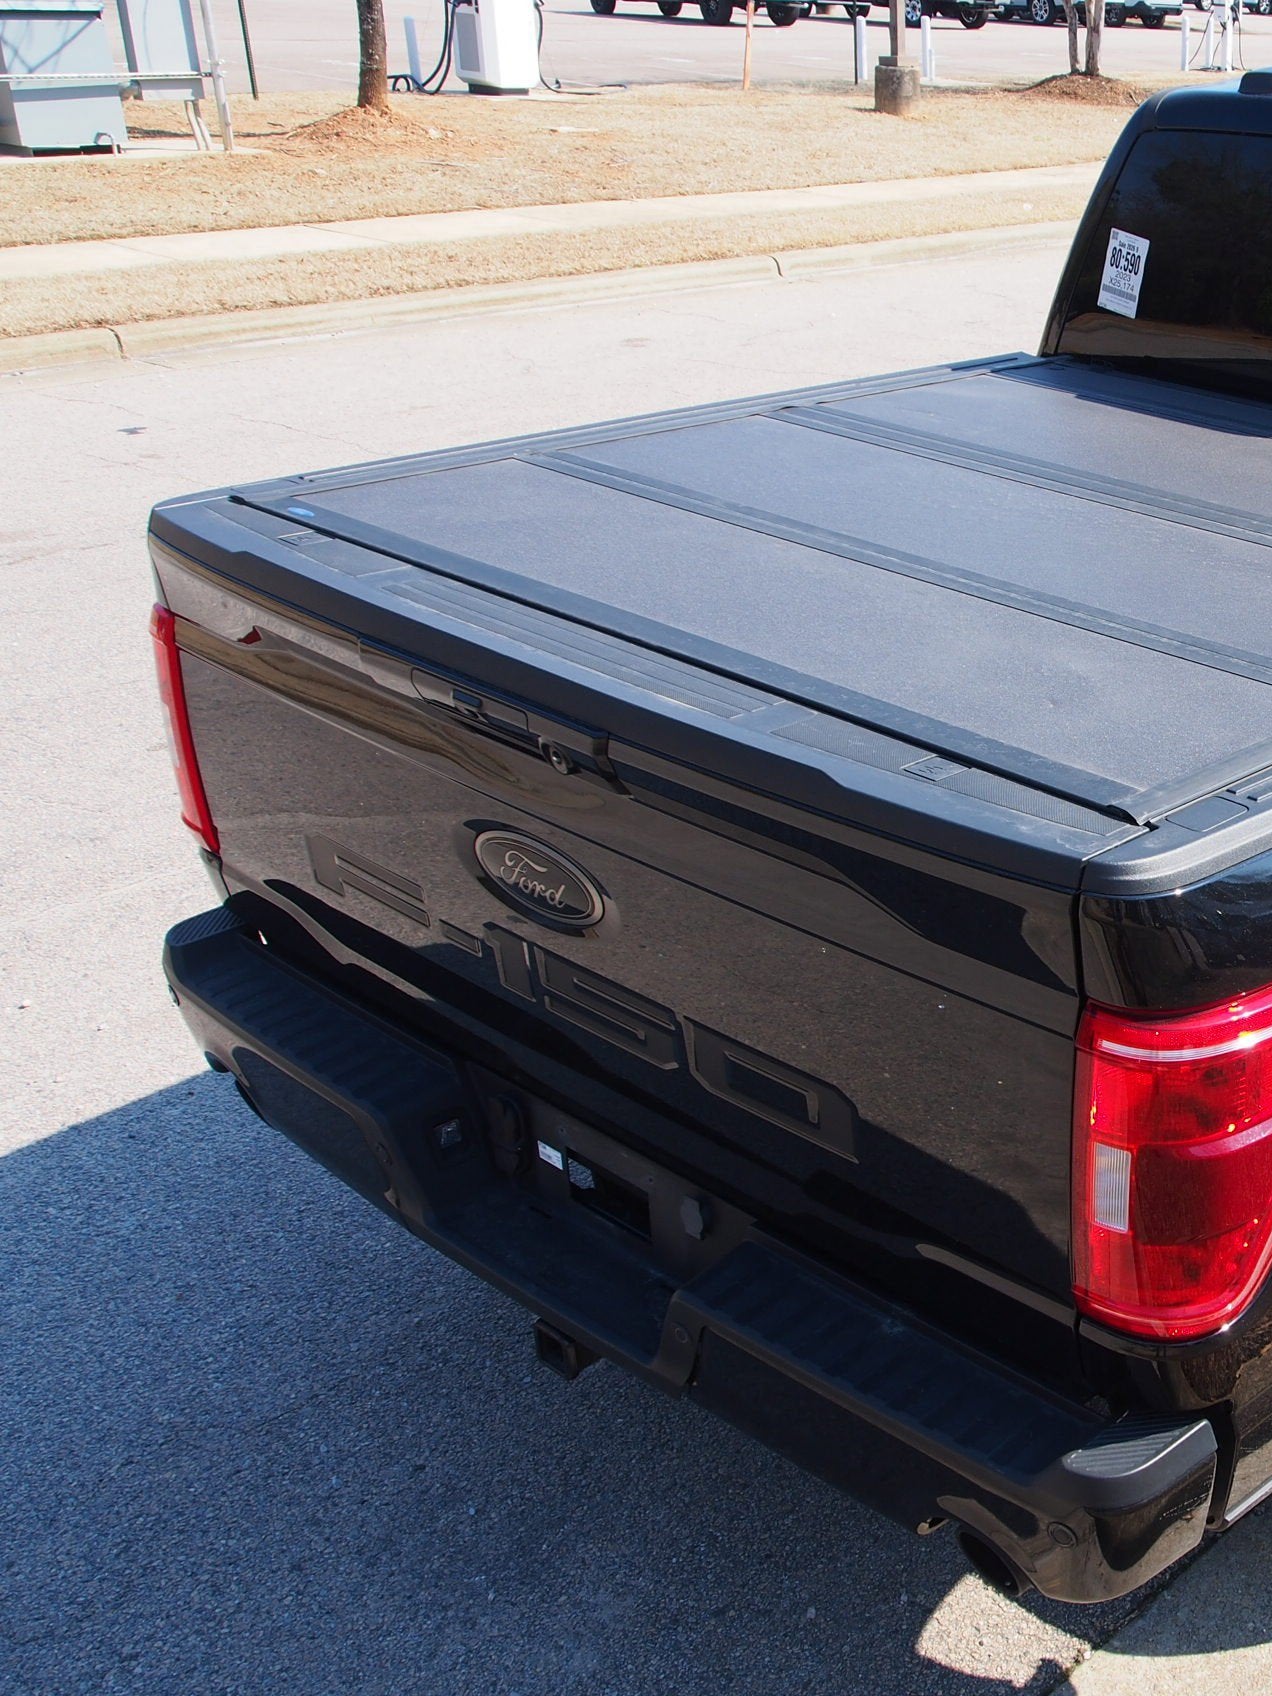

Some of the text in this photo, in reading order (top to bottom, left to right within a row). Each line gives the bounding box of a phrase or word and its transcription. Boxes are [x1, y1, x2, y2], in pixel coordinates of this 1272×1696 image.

[1109, 246, 1141, 276] 80:590
[500, 850, 566, 908] Ford
[305, 832, 859, 1165] F-150
